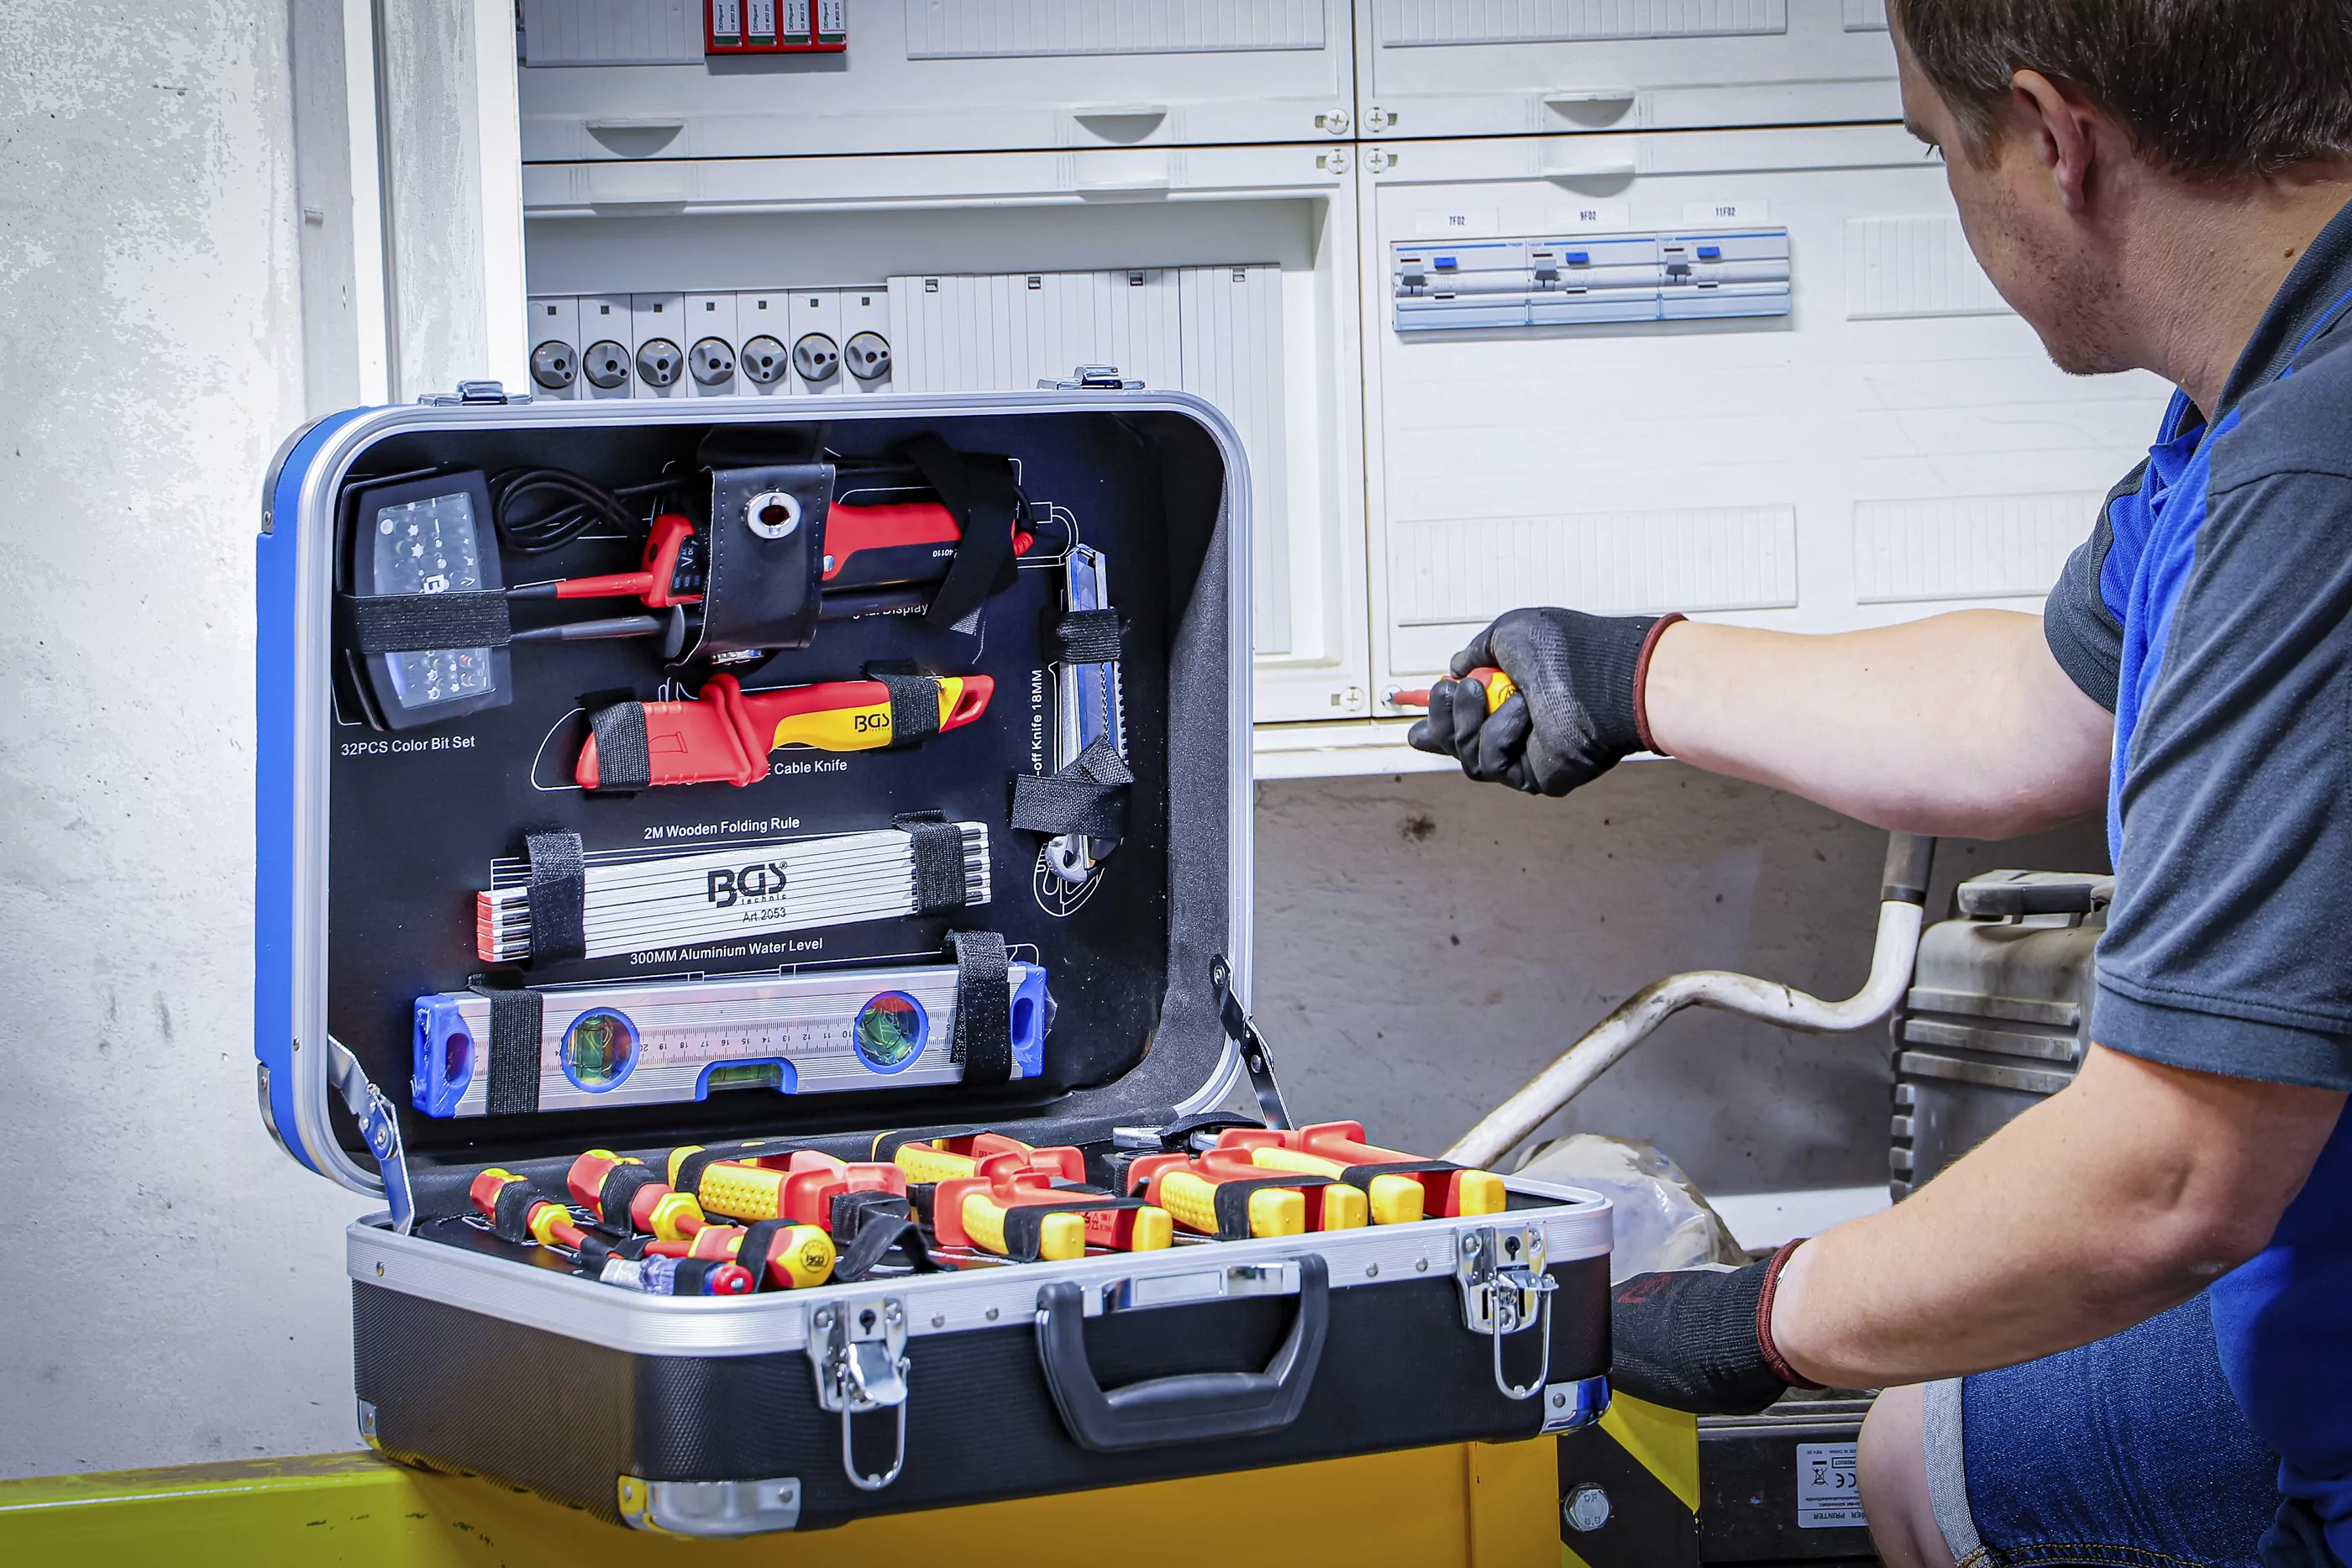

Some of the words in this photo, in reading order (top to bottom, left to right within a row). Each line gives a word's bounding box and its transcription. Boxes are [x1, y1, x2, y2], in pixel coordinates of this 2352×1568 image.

[932, 548, 953, 558] 40110
[1032, 669, 1042, 711] 18MM
[854, 713, 890, 732] BGS
[1032, 714, 1042, 752] Knife
[341, 741, 388, 755] 32PCS
[391, 739, 428, 753] Color
[431, 737, 449, 750] Bit
[452, 736, 475, 748] Set
[774, 761, 811, 775] Cable
[814, 758, 848, 772] Knife
[643, 826, 664, 840] 2M
[666, 822, 717, 837] Wooden
[721, 819, 768, 834] Folding
[770, 816, 801, 830] Rule
[741, 893, 786, 905] technic
[743, 907, 786, 923] Art.2053
[630, 949, 677, 965] 300MM
[679, 945, 746, 961] Aluminium
[748, 941, 786, 955] Water
[789, 937, 823, 952] Level
[842, 1030, 853, 1038] 10
[659, 1041, 668, 1050] 19
